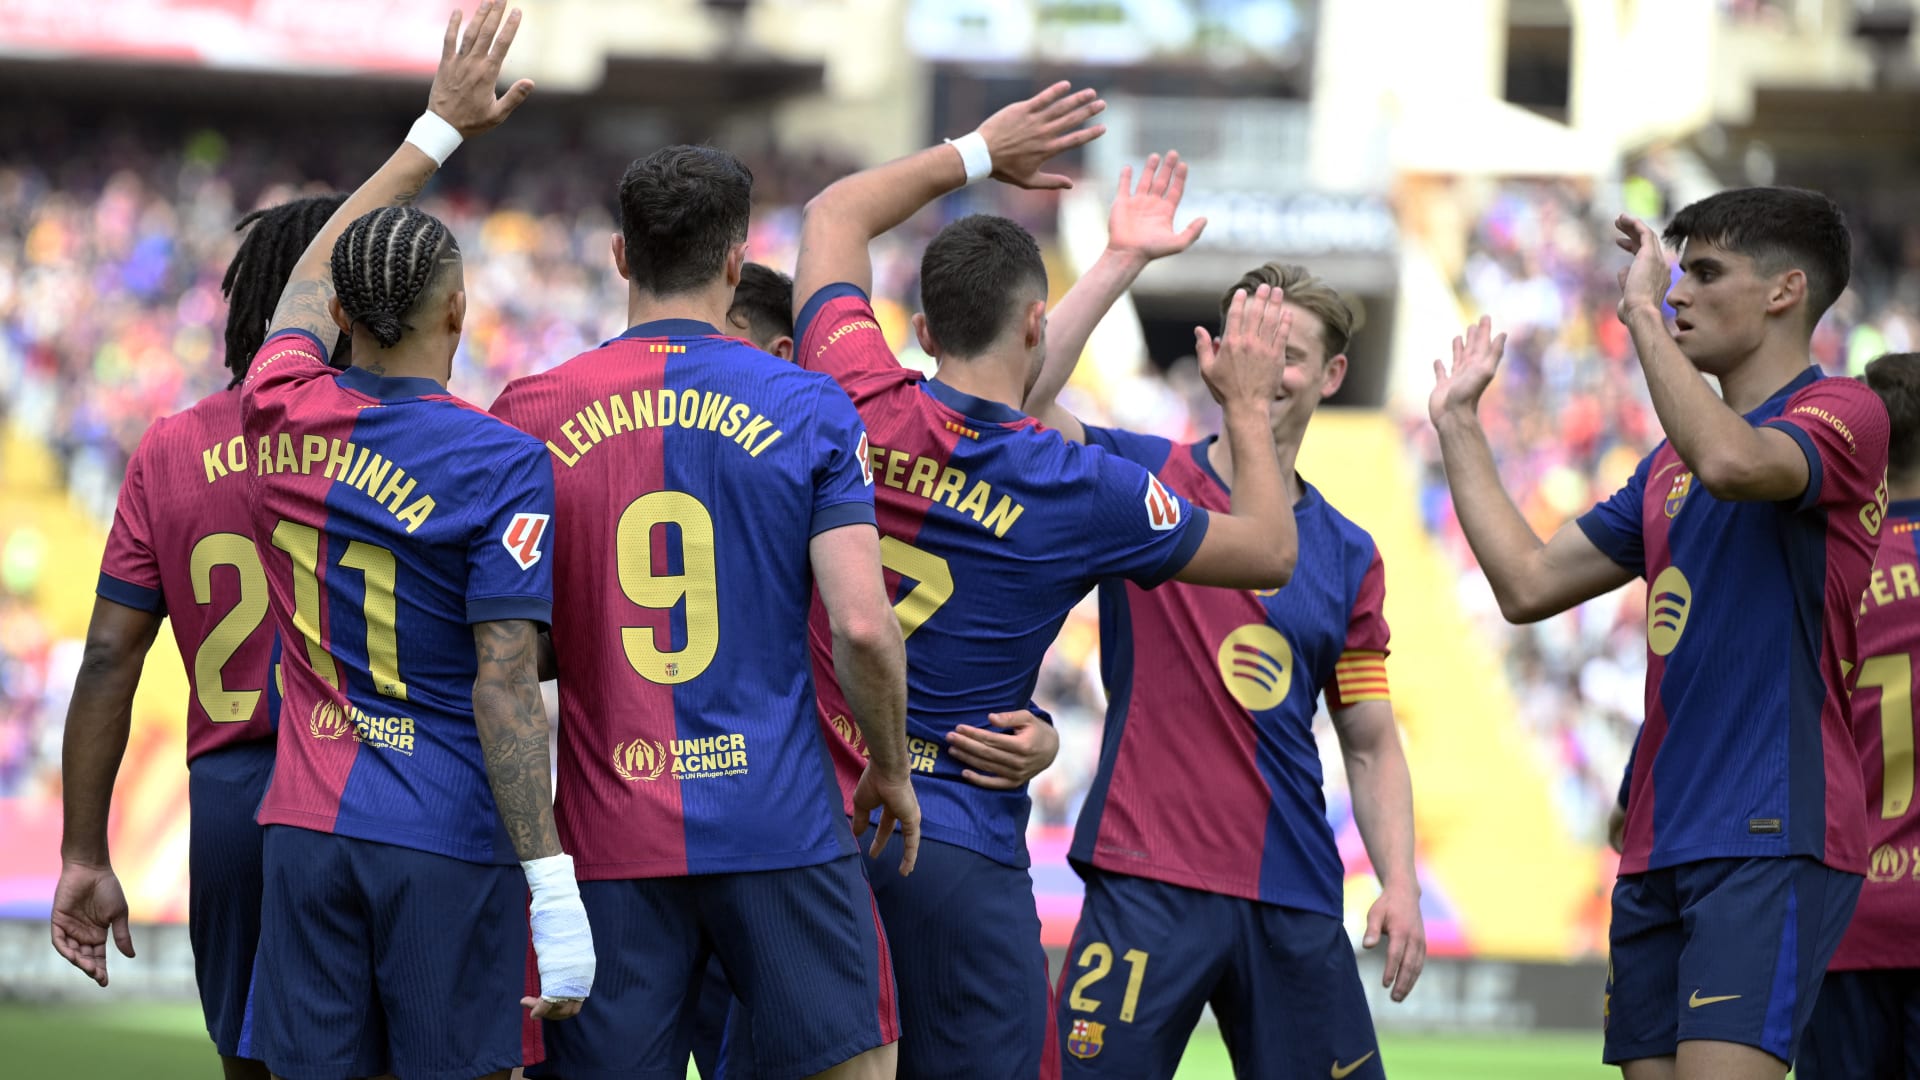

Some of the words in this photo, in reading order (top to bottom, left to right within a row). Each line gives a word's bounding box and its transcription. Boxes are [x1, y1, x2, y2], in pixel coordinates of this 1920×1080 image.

[545, 388, 783, 468] LEWANDOWSKI
[1792, 406, 1854, 443] AMBILIGHT
[257, 432, 437, 534] RAPHINHA
[868, 445, 1025, 539] FERRAN
[1858, 464, 1889, 537] GE
[189, 532, 284, 723] 2
[271, 519, 408, 700] 11
[616, 489, 720, 686] 9
[879, 534, 955, 642] 7
[344, 705, 415, 734] UNHCR
[353, 722, 414, 750] ACNUR
[669, 733, 746, 756] UNHCR
[670, 751, 748, 773] ACNUR
[685, 772, 696, 780] UN
[697, 770, 724, 779] Refugee
[724, 768, 748, 777] Agency
[1069, 942, 1149, 1023] 21
